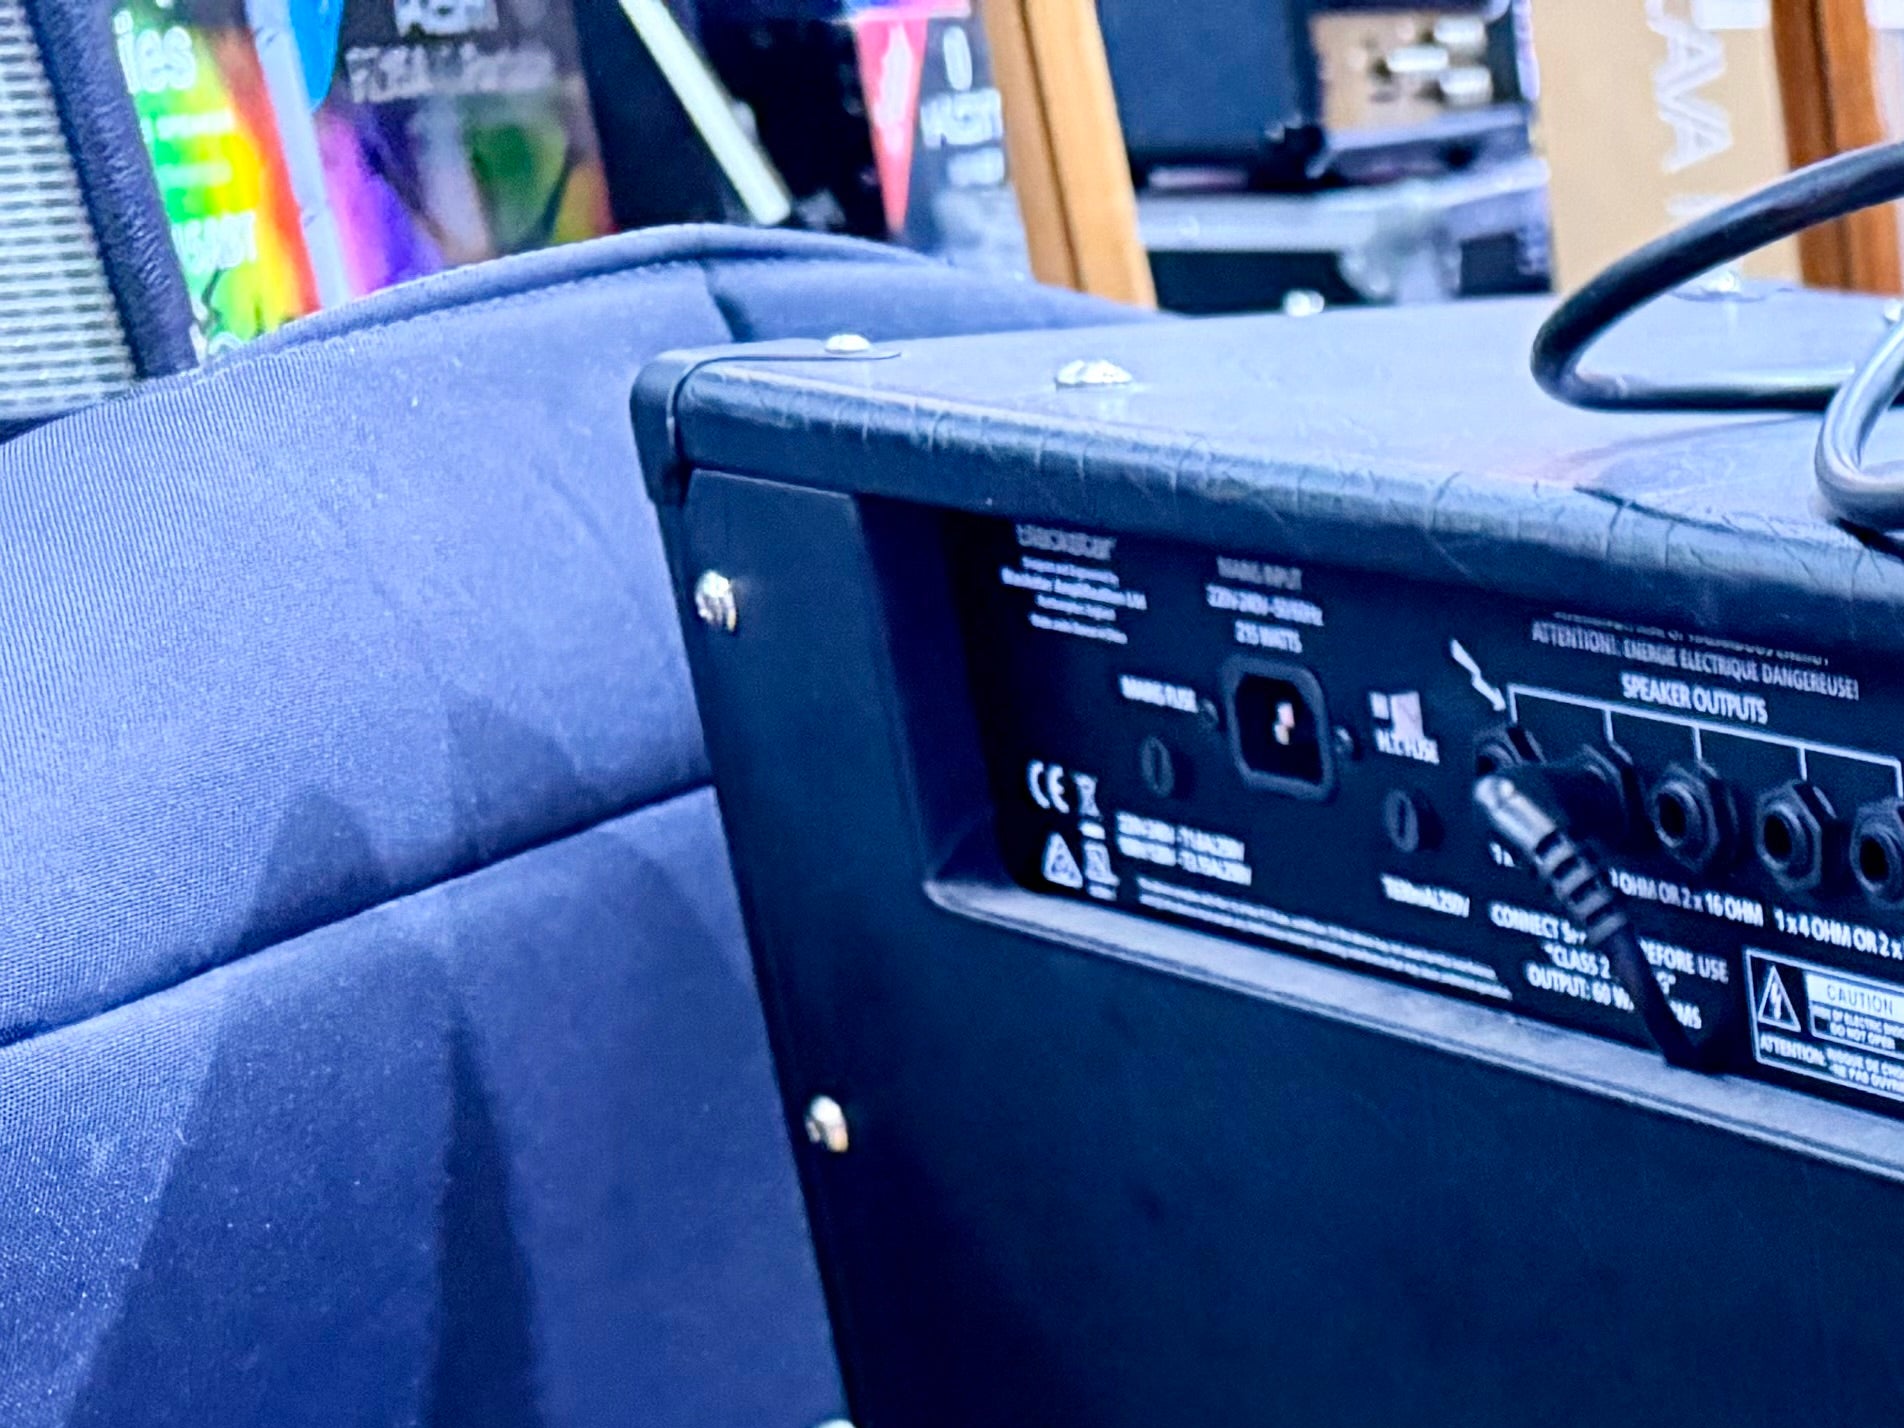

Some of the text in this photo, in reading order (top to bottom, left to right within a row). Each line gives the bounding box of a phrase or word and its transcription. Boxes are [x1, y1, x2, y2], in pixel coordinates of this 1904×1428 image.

[1646, 0, 1733, 174] AVA
[1680, 648, 1758, 683] ELECTRIQUE
[1621, 671, 1768, 724] SPEAKER OUTPUTS
[1620, 871, 1657, 900] OHM
[1658, 881, 1681, 905] OR
[1681, 885, 1692, 909] 2
[1704, 891, 1723, 917] 16
[1724, 896, 1764, 927] OHM
[1490, 902, 1559, 939] CONNECT
[1774, 907, 1785, 932] 1
[1786, 914, 1798, 936] x
[1797, 912, 1810, 938] 4
[1811, 917, 1851, 948] OHM
[1853, 928, 1879, 954] OR
[1879, 932, 1890, 957] 2
[1891, 940, 1903, 961] x
[1525, 960, 1591, 1000] OUTPUT:
[1599, 954, 1611, 979] 2
[1698, 955, 1729, 984] USE
[1826, 984, 1894, 1015] CAUTION
